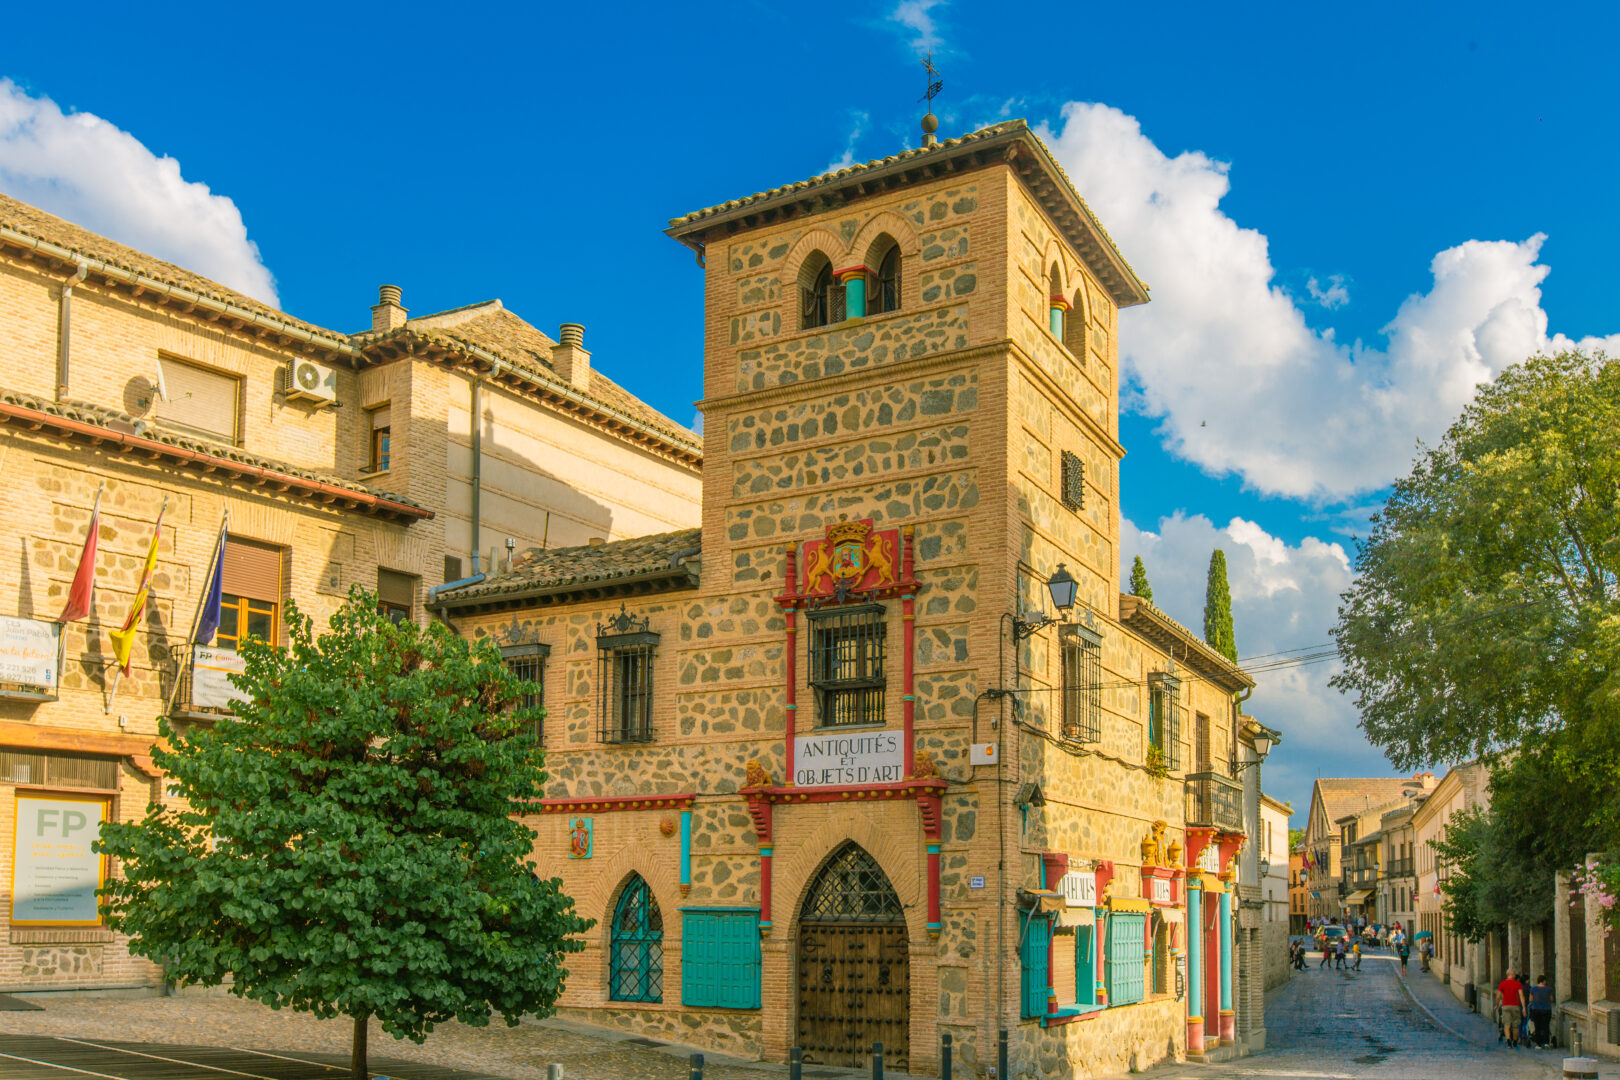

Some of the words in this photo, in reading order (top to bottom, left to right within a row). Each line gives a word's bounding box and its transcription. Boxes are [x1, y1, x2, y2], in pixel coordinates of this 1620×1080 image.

[200, 651, 212, 660] FP
[803, 733, 897, 758] ANTIQUITÉS
[841, 757, 856, 766] ET
[797, 767, 854, 785] OBJETS
[858, 764, 902, 783] D'ART
[37, 808, 87, 838] FP
